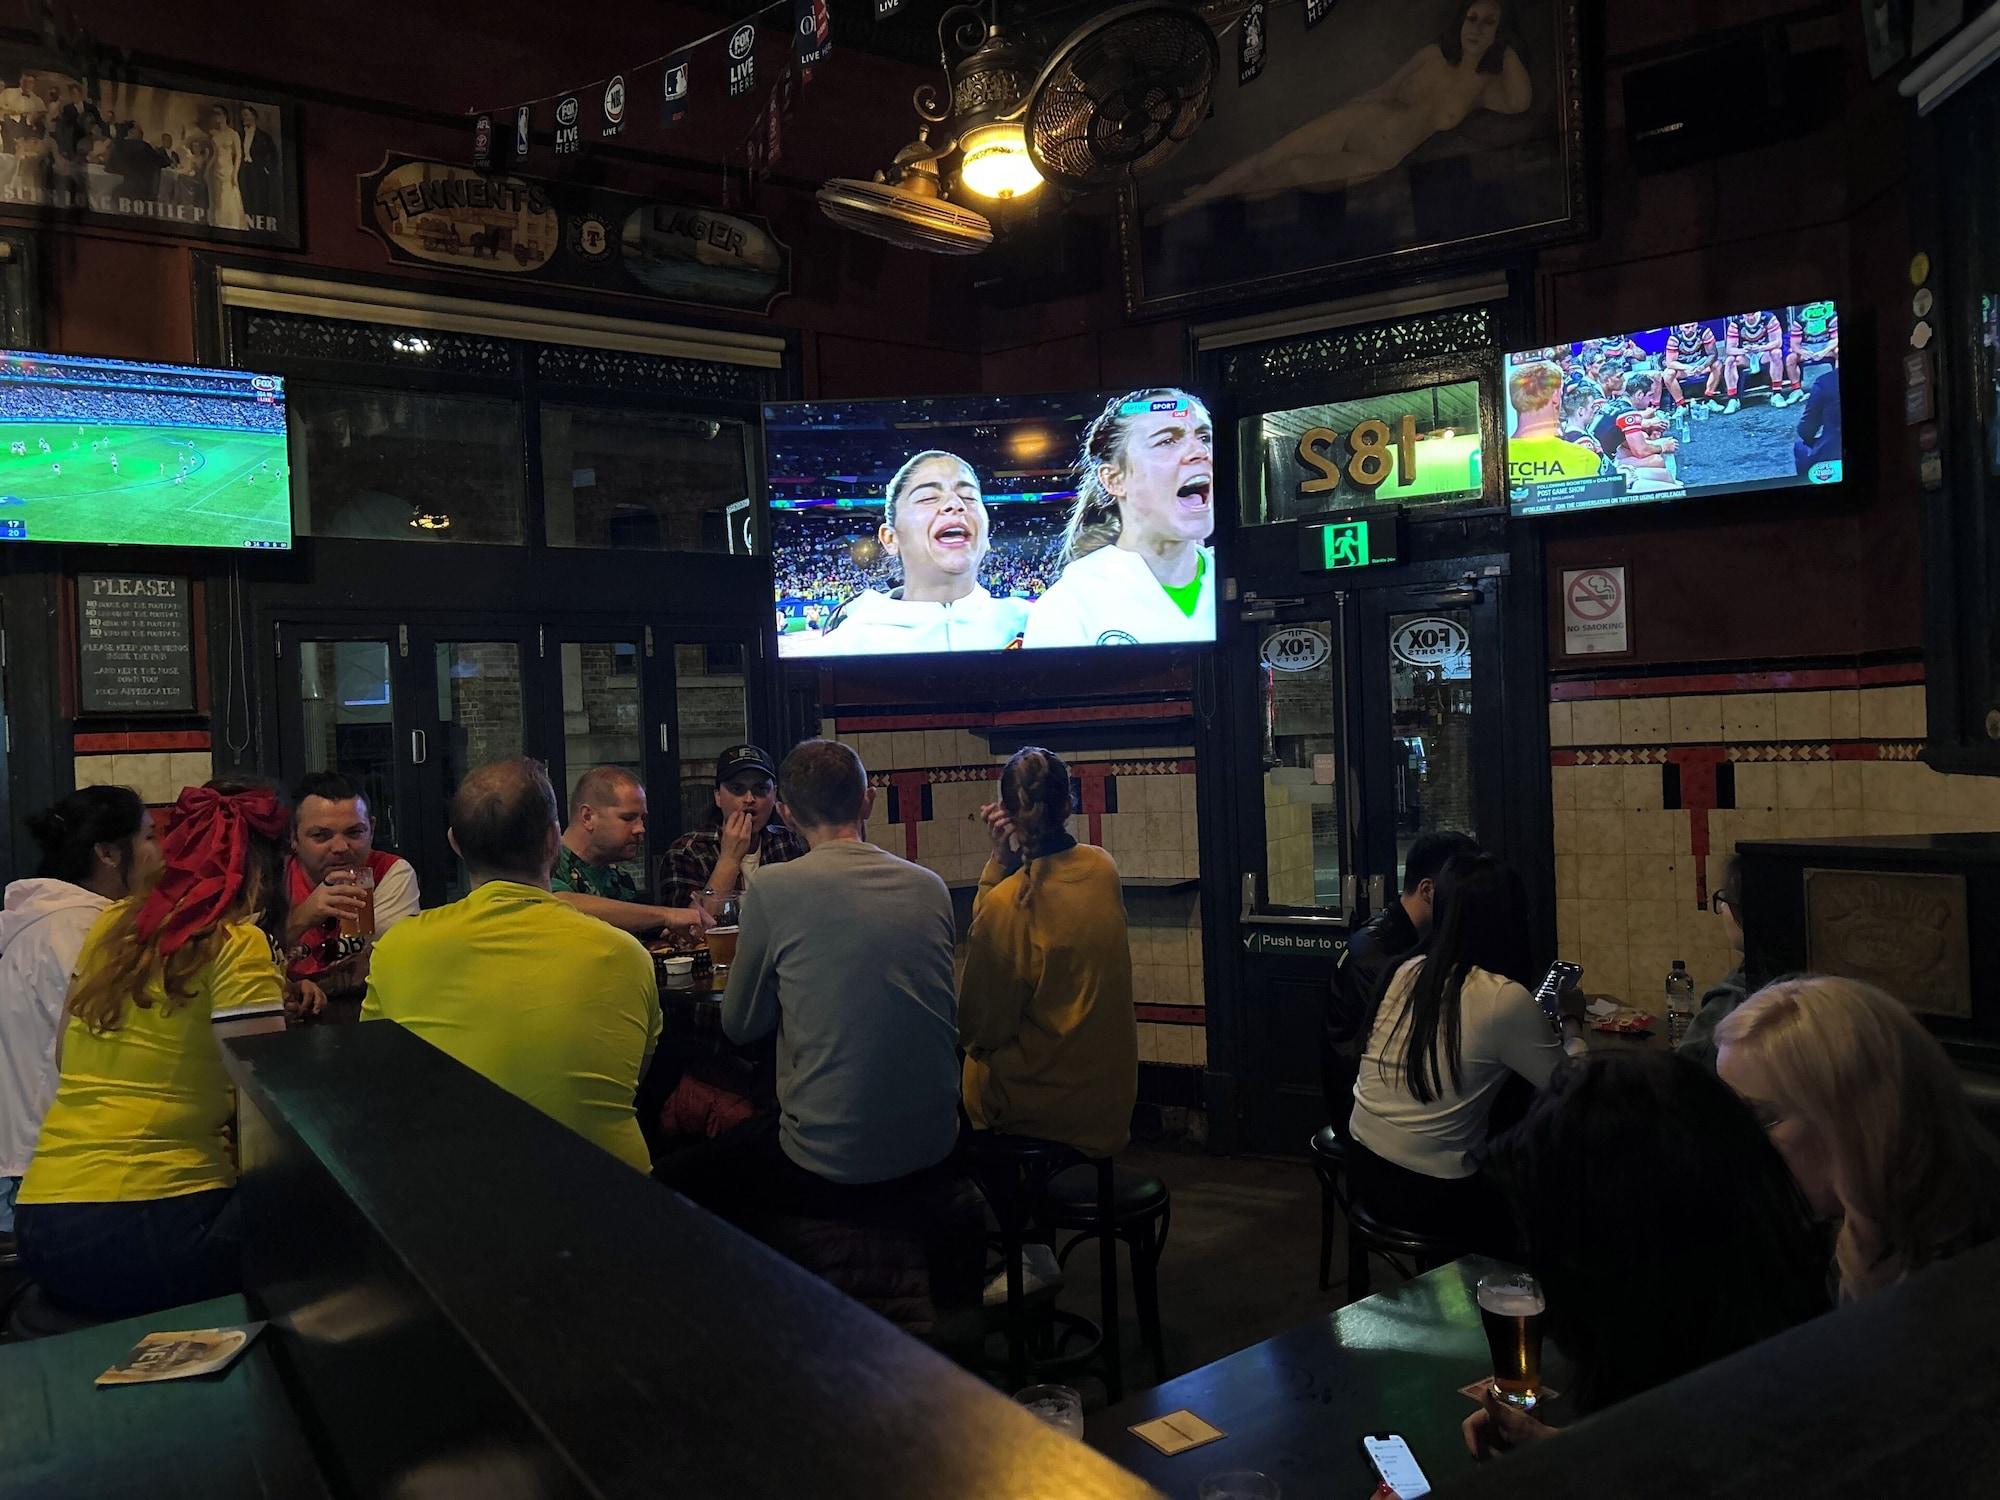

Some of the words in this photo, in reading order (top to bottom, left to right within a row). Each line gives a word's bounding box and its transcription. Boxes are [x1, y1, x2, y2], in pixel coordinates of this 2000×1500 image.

[880, 0, 899, 12] LIVE
[801, 51, 820, 64] LIVE
[730, 56, 753, 83] LIVE
[1241, 65, 1256, 80] LIVE
[730, 73, 753, 96] HERE
[556, 125, 578, 143] LIVE
[603, 127, 616, 136] LIVE
[555, 141, 578, 153] HERE
[118, 196, 185, 220] BOTTLE
[652, 206, 747, 257] LAGER
[588, 230, 599, 247] T
[256, 378, 273, 388] FOX
[1153, 402, 1176, 410] SPORT
[1537, 489, 1552, 498] POST
[1552, 487, 1568, 496] GAME
[1569, 485, 1585, 494] SHOW
[1618, 495, 1639, 504] TWITTER
[93, 579, 176, 597] PLEASE!
[86, 600, 97, 608] NO
[89, 618, 101, 626] NO
[1567, 625, 1580, 633] NO
[1582, 622, 1624, 632] SMOKING
[90, 628, 102, 636] NO
[1263, 935, 1293, 947] Push
[1296, 936, 1316, 948] bar
[1319, 937, 1331, 949] to
